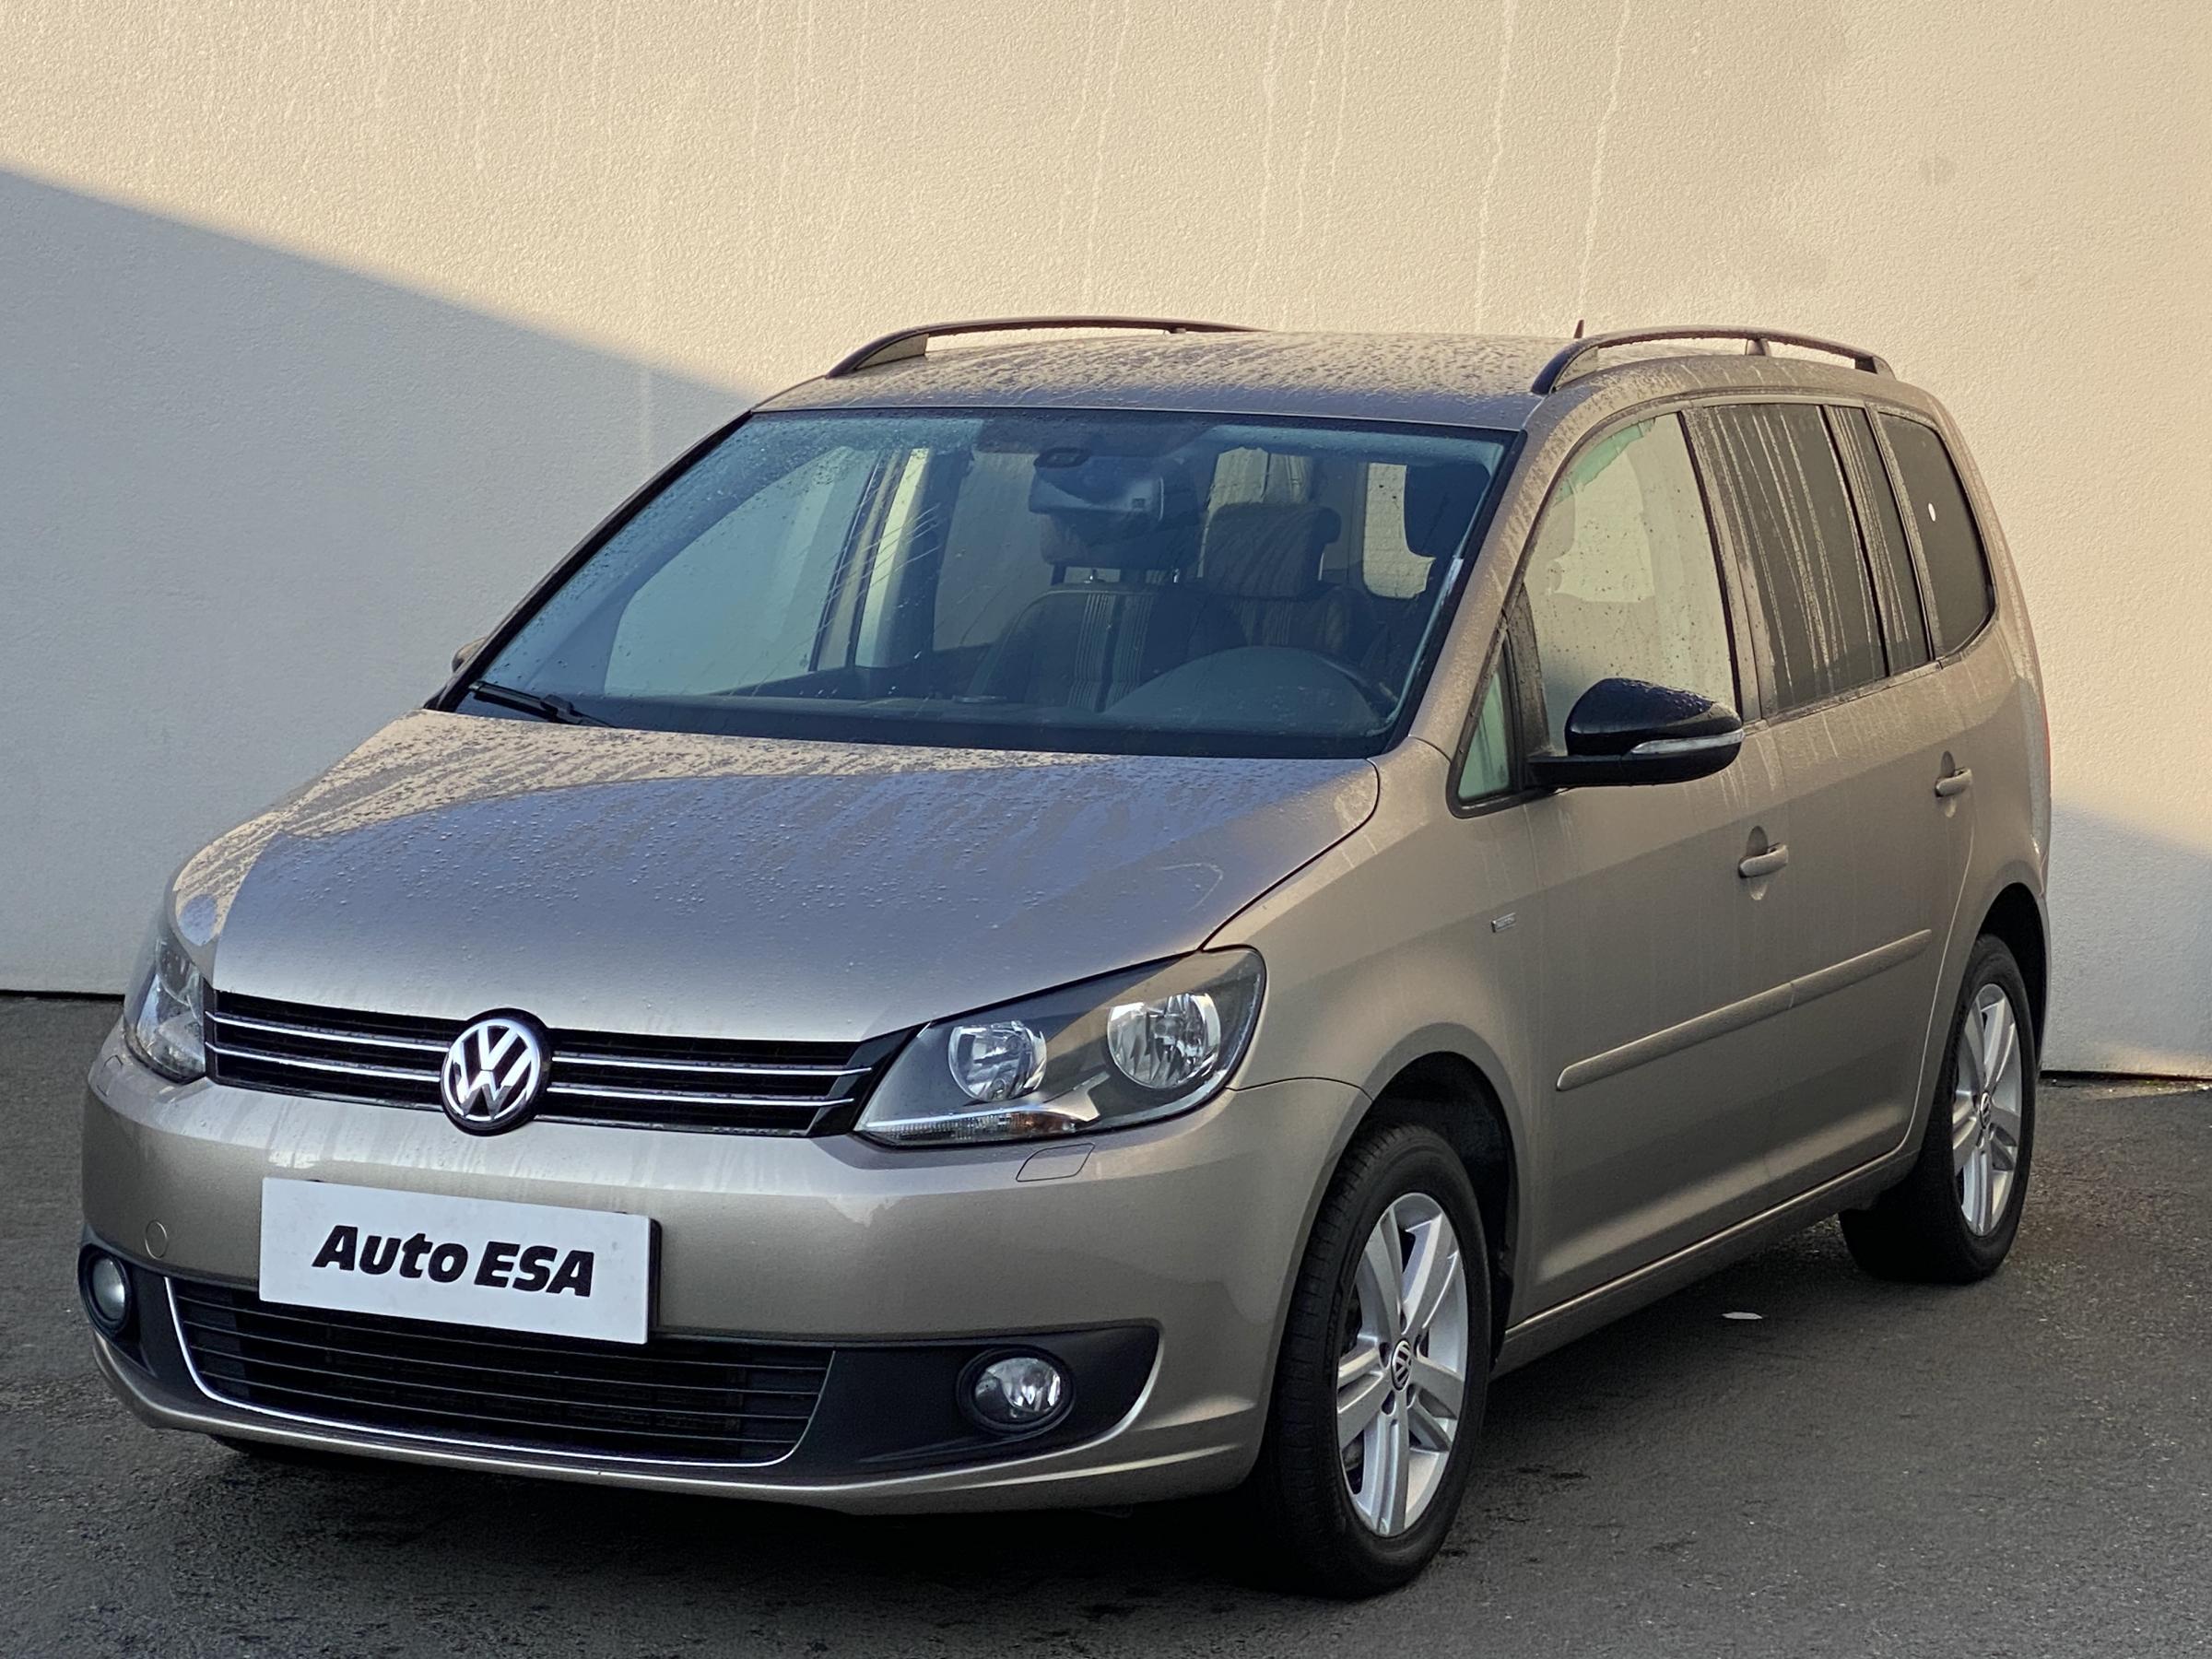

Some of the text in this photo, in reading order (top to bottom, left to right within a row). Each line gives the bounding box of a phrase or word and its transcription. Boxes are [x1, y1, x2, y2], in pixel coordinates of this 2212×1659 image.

[442, 1018, 540, 1122] VW
[312, 1225, 594, 1297] Auto ESA
